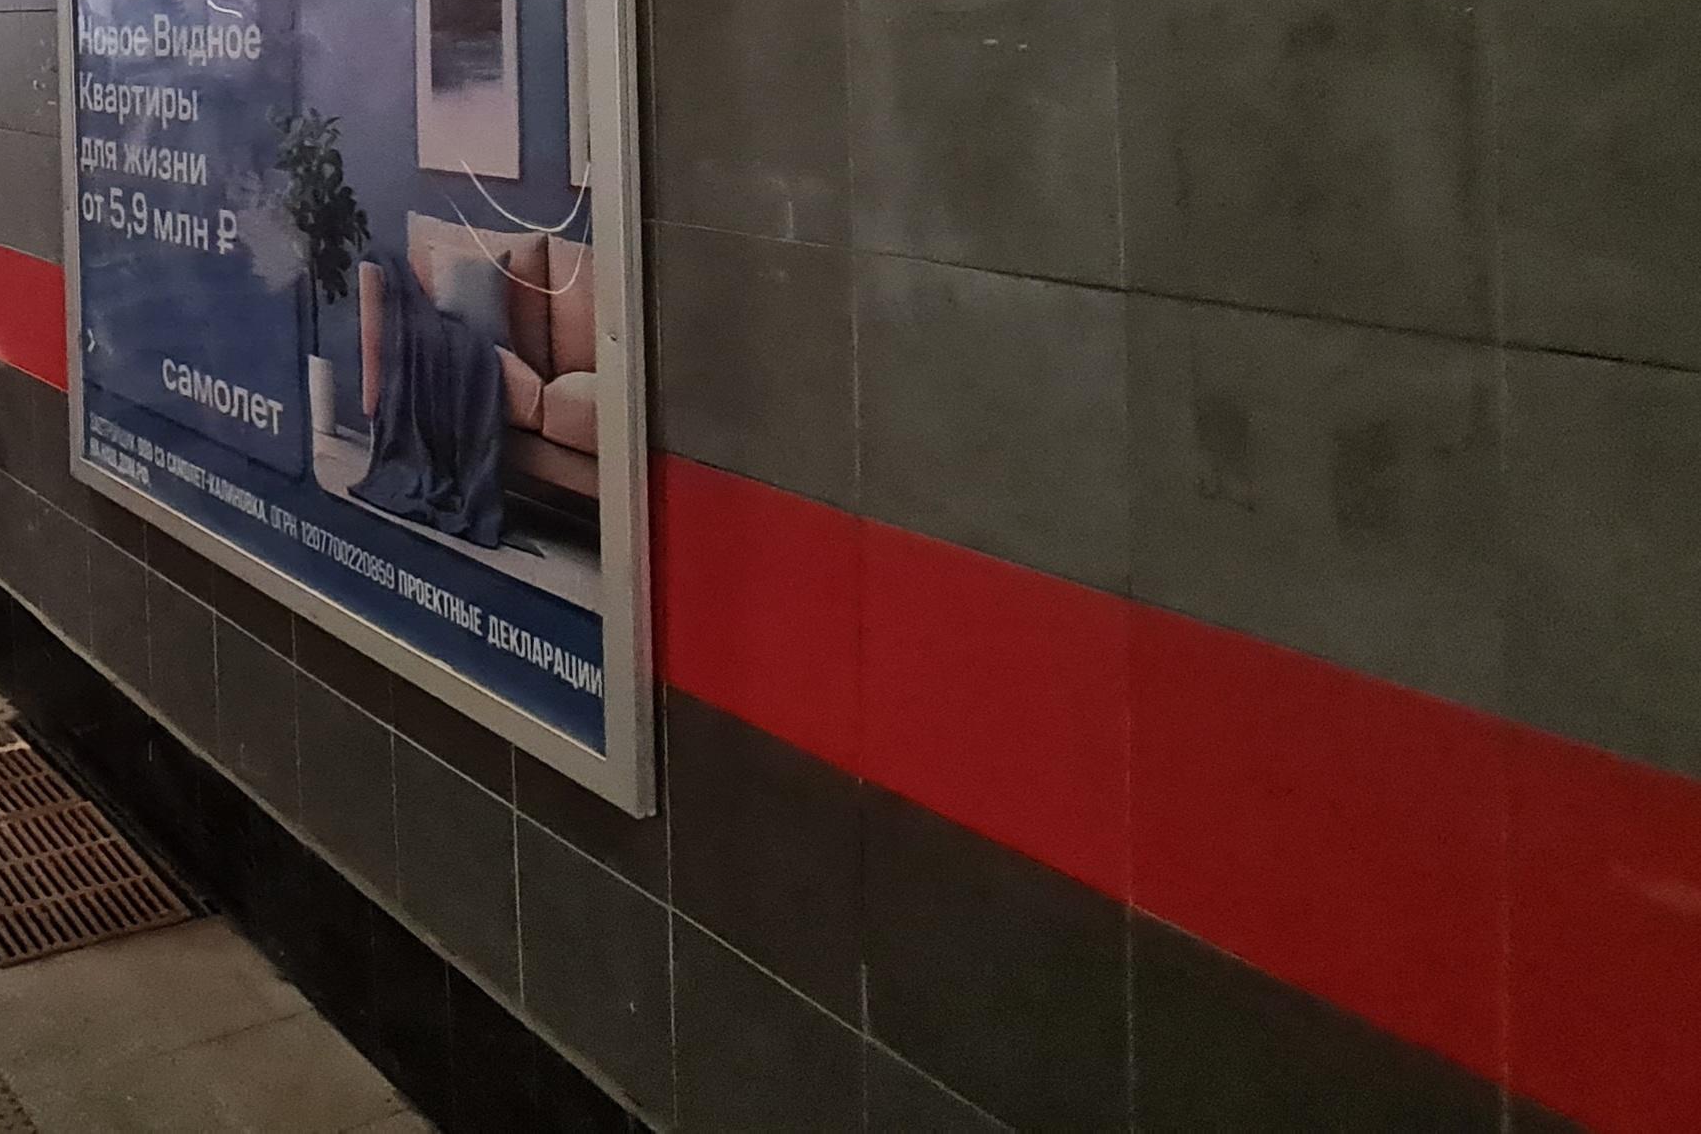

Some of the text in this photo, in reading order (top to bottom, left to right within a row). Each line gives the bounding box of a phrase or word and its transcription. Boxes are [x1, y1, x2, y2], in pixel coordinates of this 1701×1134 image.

[77, 13, 262, 67] Новое Видное
[79, 70, 199, 131] Квартиры
[80, 136, 208, 187] для жизни
[82, 191, 105, 224] от
[109, 187, 149, 240] 5,9
[153, 207, 210, 252] млн
[162, 357, 284, 436] самолет
[300, 519, 396, 590] 1207700220859
[398, 568, 484, 637] ПРОЕКТНЫЕ
[487, 613, 603, 698] ДЕКЛАРАЦИИ
